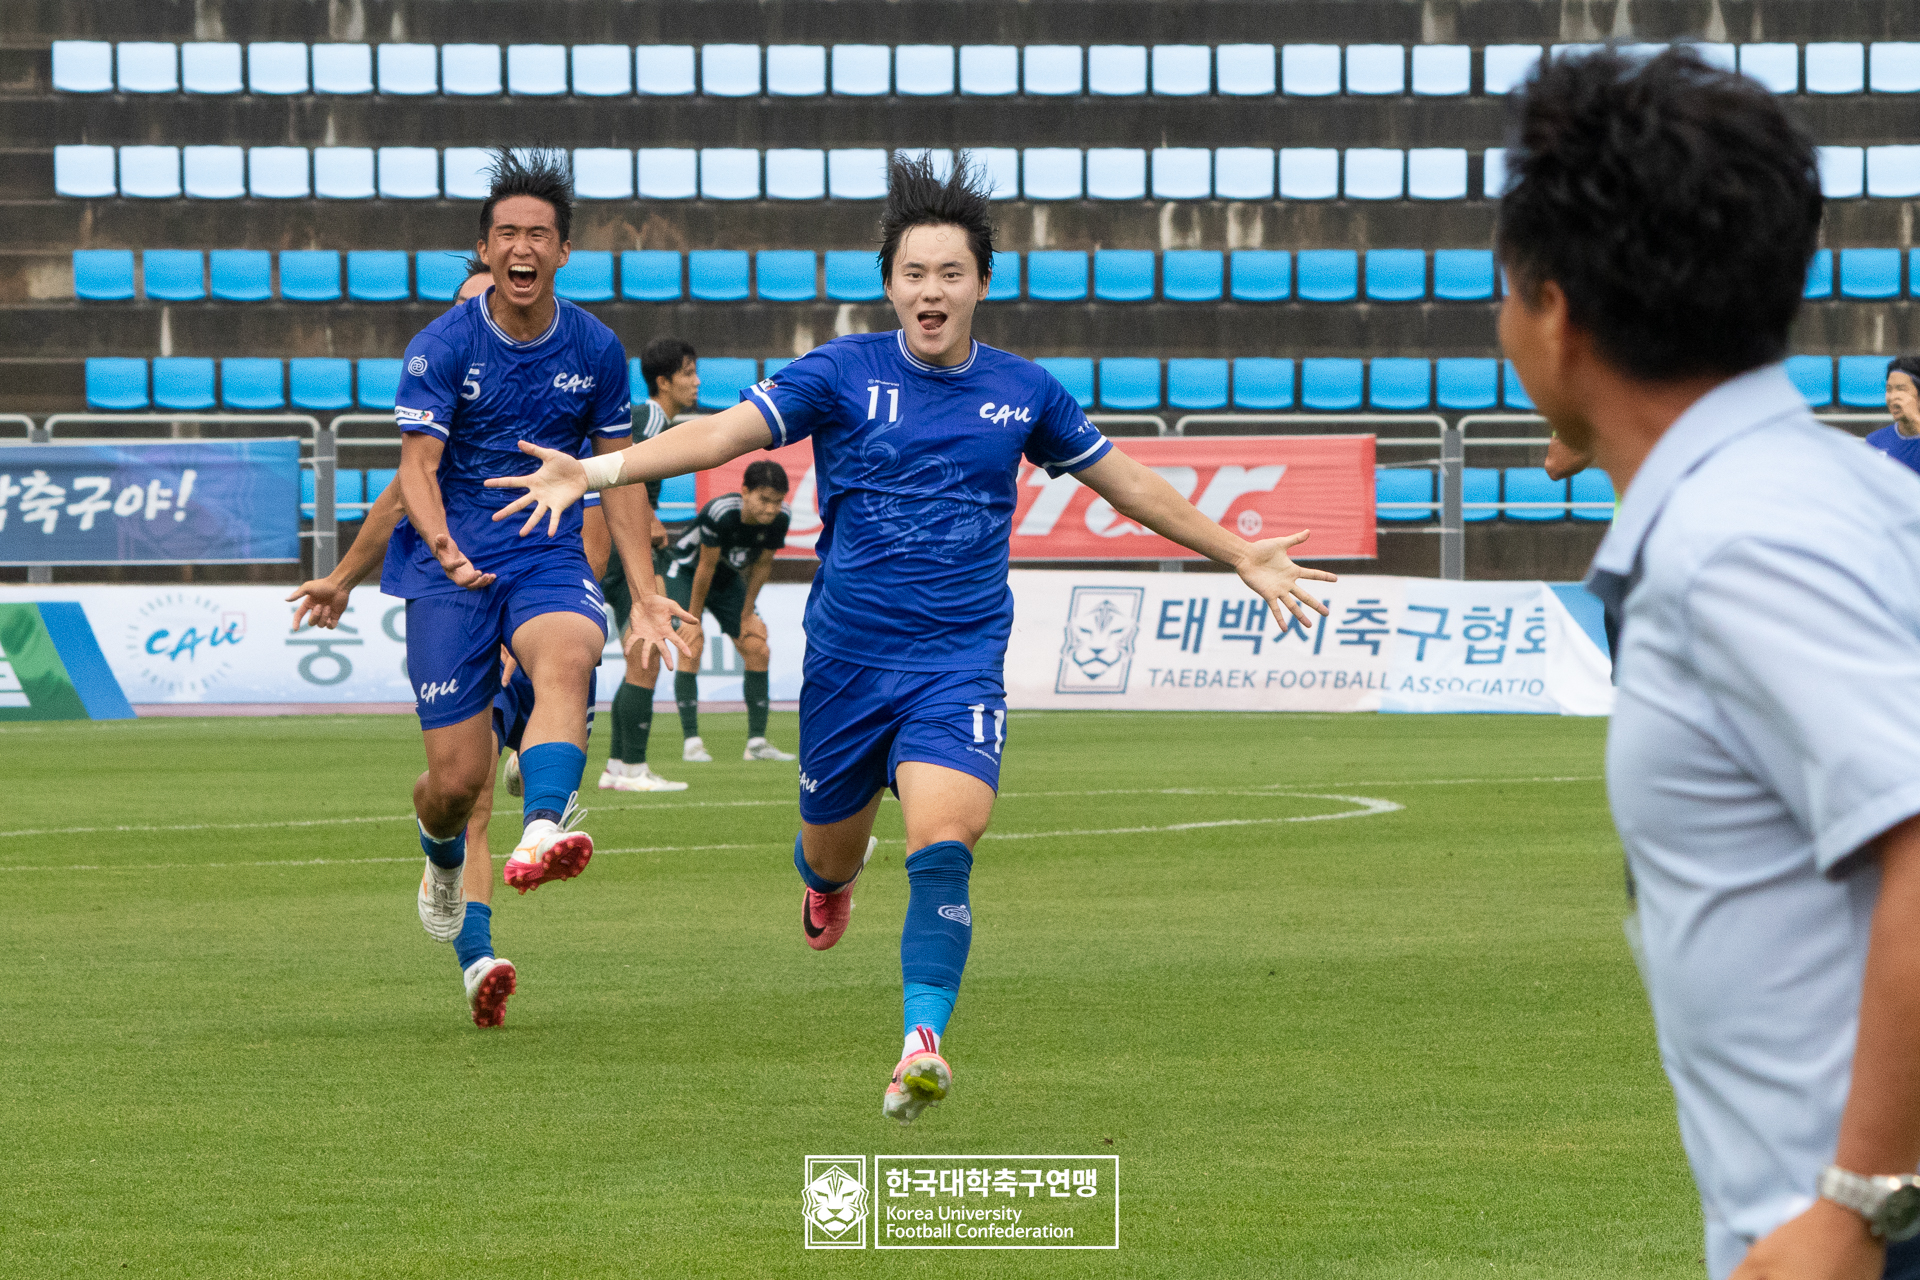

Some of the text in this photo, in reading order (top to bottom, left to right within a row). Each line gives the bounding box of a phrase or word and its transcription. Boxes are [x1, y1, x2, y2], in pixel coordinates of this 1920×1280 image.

[460, 367, 481, 401] 5
[866, 385, 899, 423] 11
[1148, 668, 1546, 697] TAEBAEK FOOTBALL ASSOCIATIO
[967, 703, 1005, 755] 11
[798, 764, 818, 793] AU
